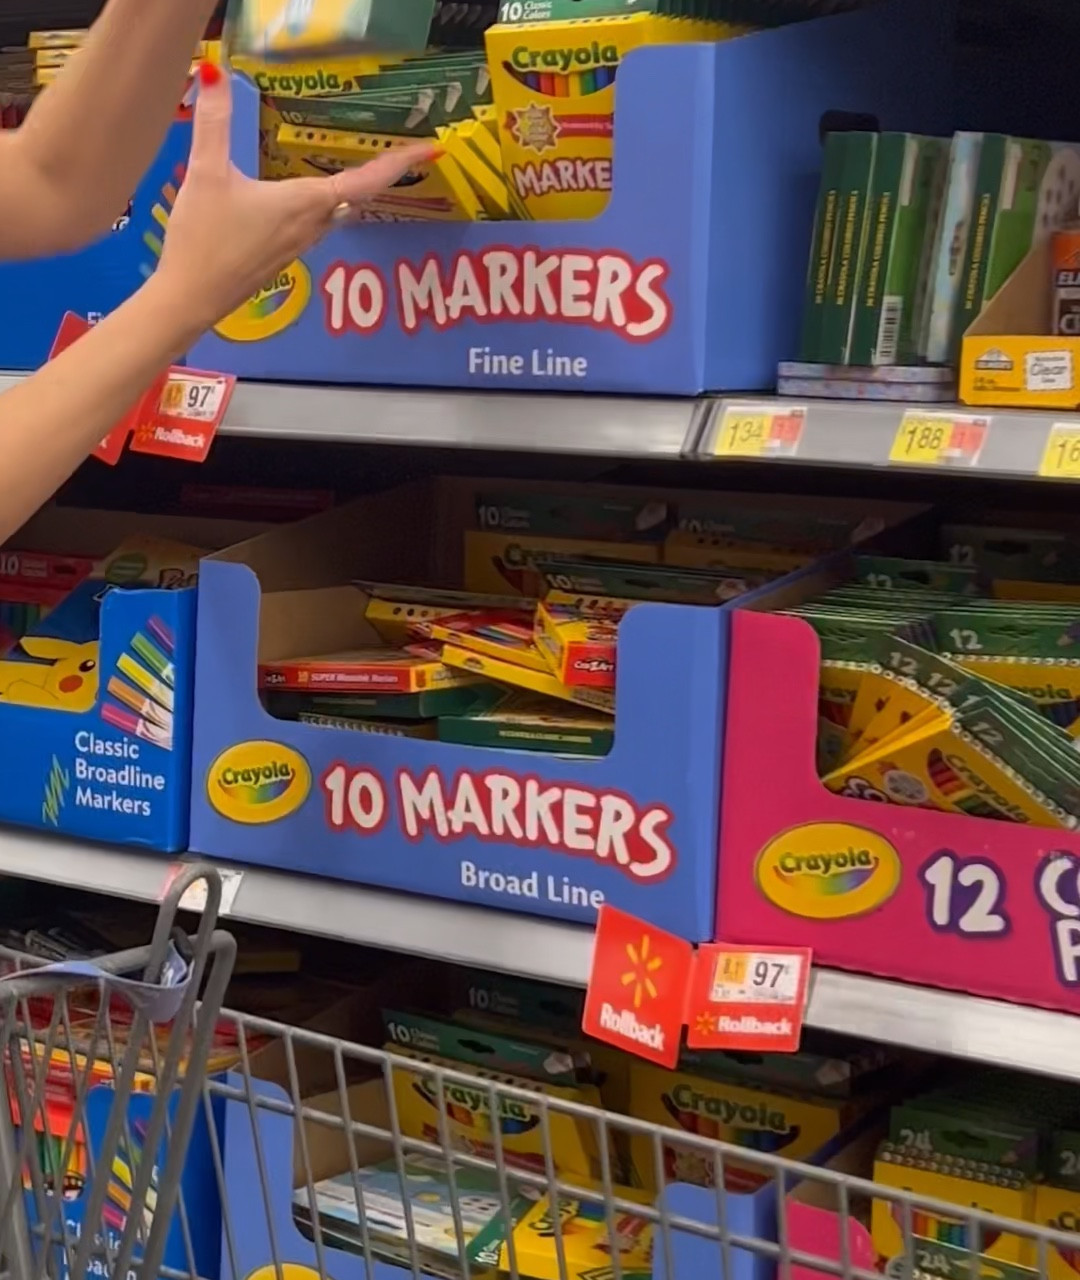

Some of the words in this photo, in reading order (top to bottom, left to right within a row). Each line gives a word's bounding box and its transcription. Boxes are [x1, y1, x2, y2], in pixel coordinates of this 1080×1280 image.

[500, 1, 522, 22] 10
[523, 0, 554, 12] Classic
[523, 9, 552, 21] Colors
[511, 41, 618, 72] Crayola
[255, 70, 341, 96] Crayola
[513, 158, 612, 200] MARKE
[323, 267, 383, 330] 10
[398, 249, 667, 337] MARKERS
[468, 346, 525, 377] Fine
[531, 348, 588, 378] Line
[155, 425, 205, 449] Rollback
[546, 573, 570, 590] 10
[949, 627, 983, 652] 12
[887, 651, 919, 676] 12
[925, 670, 957, 695] 12
[74, 730, 140, 760] Classic
[971, 720, 1004, 746] 12
[75, 757, 166, 790] Broadline
[75, 785, 152, 817] Markers
[222, 759, 291, 788] Crayola
[325, 766, 384, 829] 10
[399, 771, 672, 878] MARKERS
[460, 861, 540, 901] Broad
[547, 875, 605, 909] Line
[778, 844, 872, 877] Crayola
[924, 854, 1006, 934] 12
[388, 1021, 410, 1043] 10
[599, 1003, 666, 1052] Rollback
[718, 1015, 793, 1037] Rollback
[422, 1075, 529, 1120] Crayla
[672, 1083, 787, 1131] Crayola
